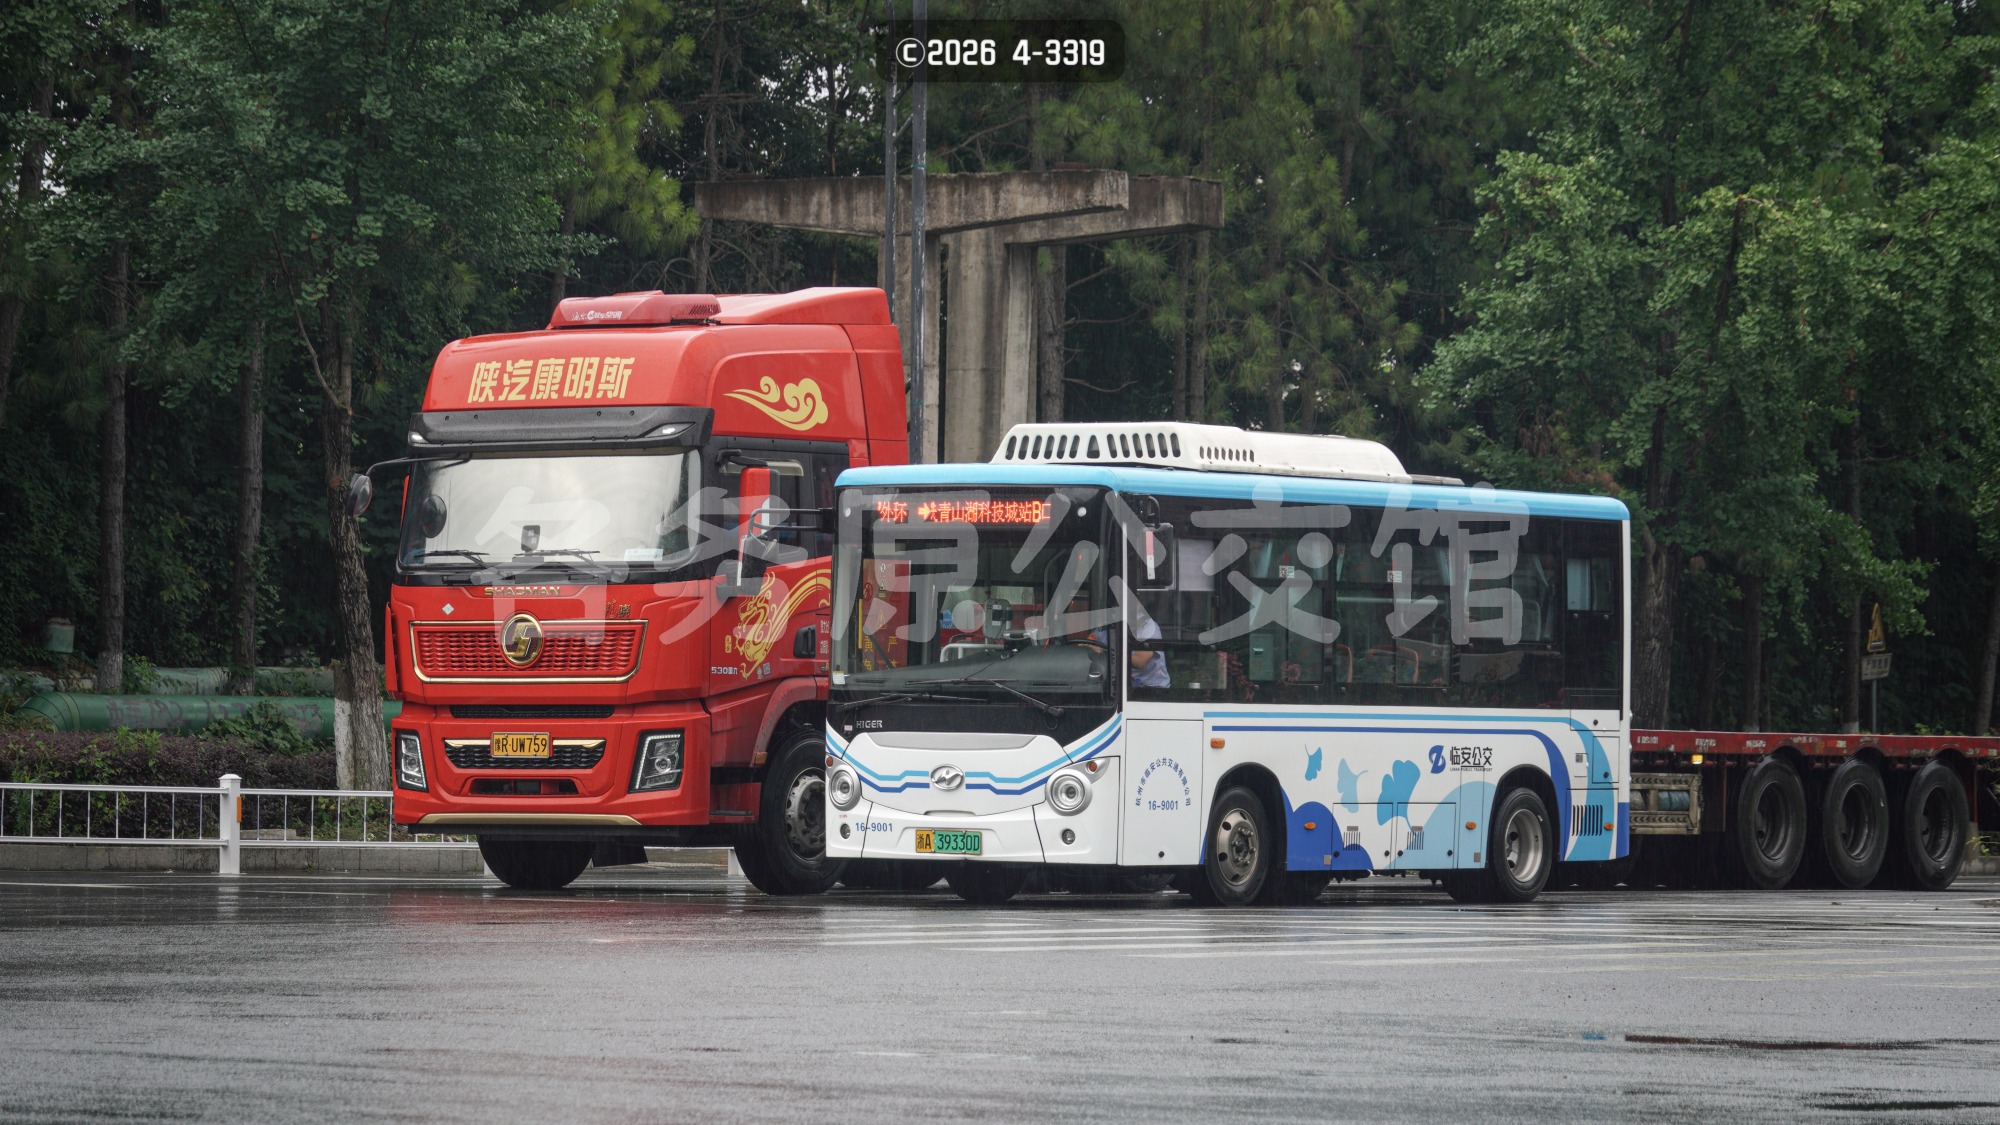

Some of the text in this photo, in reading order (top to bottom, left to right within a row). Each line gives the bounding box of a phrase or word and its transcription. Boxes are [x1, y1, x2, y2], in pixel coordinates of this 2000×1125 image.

[467, 356, 635, 403] 陕汽康明斯
[484, 586, 561, 596] SHACMAN
[856, 720, 883, 729] HIGER
[1450, 745, 1493, 766] 临安公交
[1148, 800, 1179, 811] 16-9001
[855, 822, 893, 832] 16-9001
